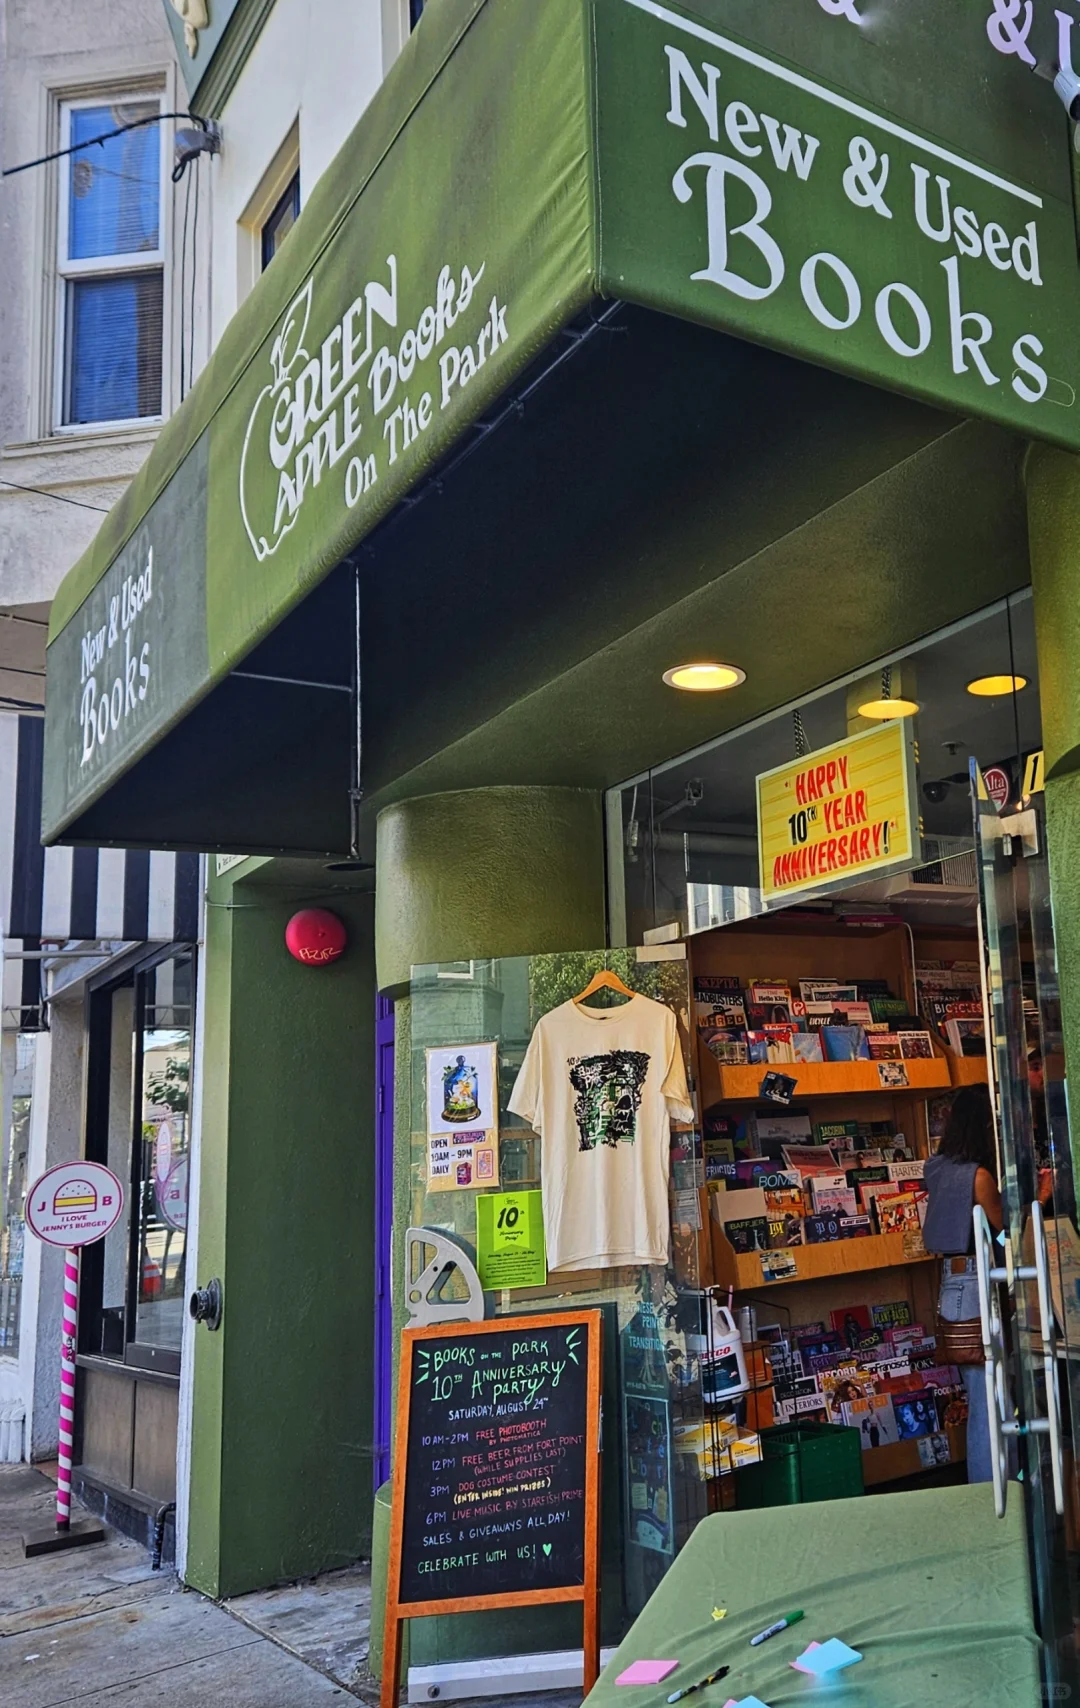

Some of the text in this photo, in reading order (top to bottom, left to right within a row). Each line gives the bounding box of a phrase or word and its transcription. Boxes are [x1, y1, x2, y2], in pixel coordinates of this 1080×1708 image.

[664, 45, 1043, 286] New & Used
[672, 151, 1047, 402] Books
[270, 254, 397, 469] GREEN
[274, 261, 485, 534] APPLE Books
[345, 296, 509, 508] On The Park
[81, 625, 106, 684] New
[108, 594, 119, 648] &
[121, 545, 152, 630] Used
[80, 628, 149, 767] Books
[795, 755, 848, 806] HAPPY
[824, 790, 867, 834] YEAR
[773, 820, 889, 887] ANNIVERSARY!
[698, 1013, 745, 1027] WIRED
[431, 1138, 448, 1148] OPEN
[431, 1151, 449, 1162] 10AM
[457, 1148, 472, 1159] 9PM
[432, 1164, 449, 1175] DAILY
[37, 1196, 112, 1212] J B
[41, 1220, 107, 1232] JENNY'S BURGER
[434, 1347, 476, 1372] BOOKS
[431, 1360, 566, 1401] 10TH ANNIVERSARY
[448, 1404, 495, 1421] SATURDAY,
[496, 1400, 530, 1416] AUGUST
[475, 1428, 495, 1441] FREE
[498, 1419, 547, 1437] PHOTOBOOTH
[462, 1454, 484, 1466] FREE
[488, 1448, 510, 1461] BEER
[513, 1443, 534, 1456] FROM
[536, 1438, 557, 1450] FORT
[559, 1434, 584, 1446] POINT
[474, 1447, 567, 1476] (WHILE SUPPLIES LAST)
[430, 1465, 555, 1497] 3PM DOG COSTUME CONTEST
[426, 1489, 583, 1525] 6PM LIVE MUSIC BY STARFISH PRIME
[453, 1493, 480, 1505] (ENTER
[423, 1510, 571, 1547] SALES & GIVEAWAYS ALL DAY!
[418, 1544, 536, 1574] CELEBRATE WITH US!
